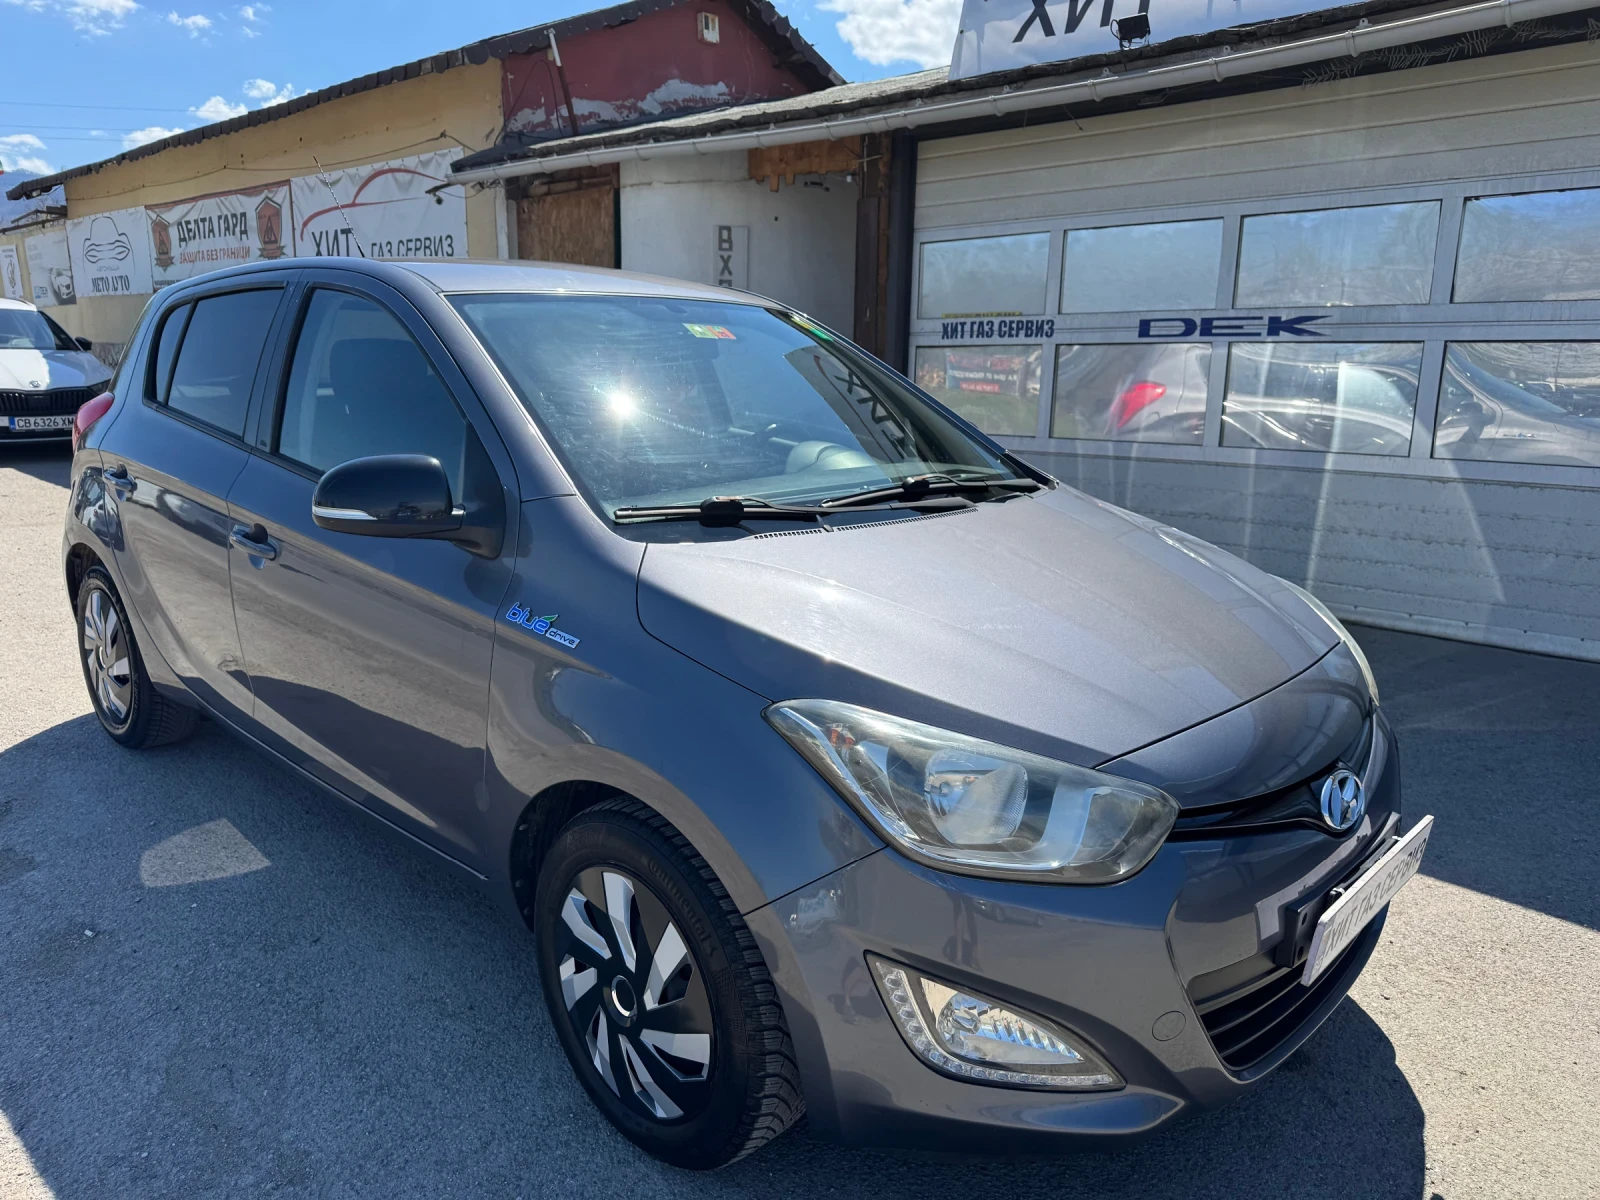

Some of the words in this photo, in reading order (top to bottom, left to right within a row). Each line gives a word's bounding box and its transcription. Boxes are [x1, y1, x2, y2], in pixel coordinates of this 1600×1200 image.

[176, 216, 215, 248] ДЕЛТА
[217, 212, 249, 241] ГАРД
[311, 227, 353, 257] ХИТ
[371, 240, 393, 257] ГАЗ
[397, 234, 455, 257] СЕРВИЗ
[180, 250, 205, 264] ЗАЩИТА
[206, 249, 219, 262] БЕЗ
[219, 246, 250, 262] ГРАНИЦИ
[941, 321, 967, 340] ХИТ
[969, 320, 995, 339] ГАЗ
[998, 319, 1055, 339] СЕРВИЗ
[1138, 315, 1334, 338] DEK
[33, 417, 59, 428] 6326
[506, 602, 551, 635] blue
[548, 629, 576, 646] drive
[1355, 881, 1381, 927] ГАЗ
[1380, 837, 1427, 901] СЕРВИЗ
[641, 857, 712, 942] Continental
